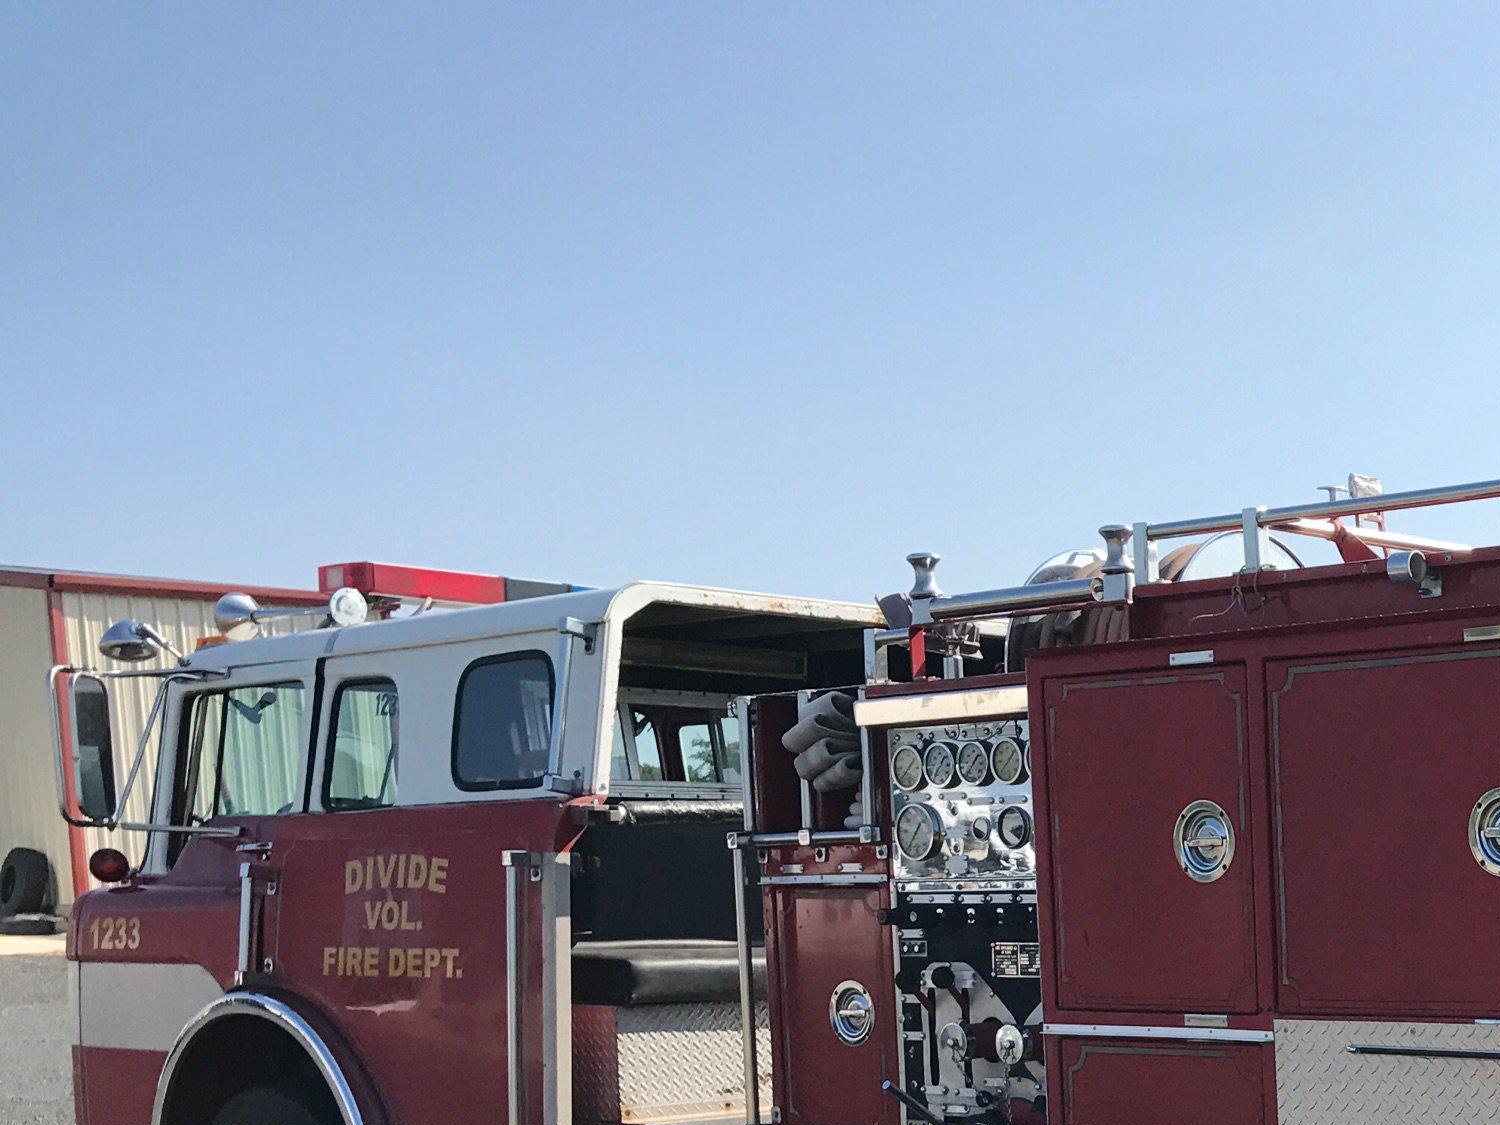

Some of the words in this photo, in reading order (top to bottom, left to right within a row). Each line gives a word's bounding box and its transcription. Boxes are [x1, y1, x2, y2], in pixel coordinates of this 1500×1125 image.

[344, 854, 449, 894] DIVIDE
[364, 901, 423, 930] VOL.
[90, 916, 141, 950] 1233
[323, 947, 380, 977] FIRE
[388, 948, 463, 978] DEPT.
